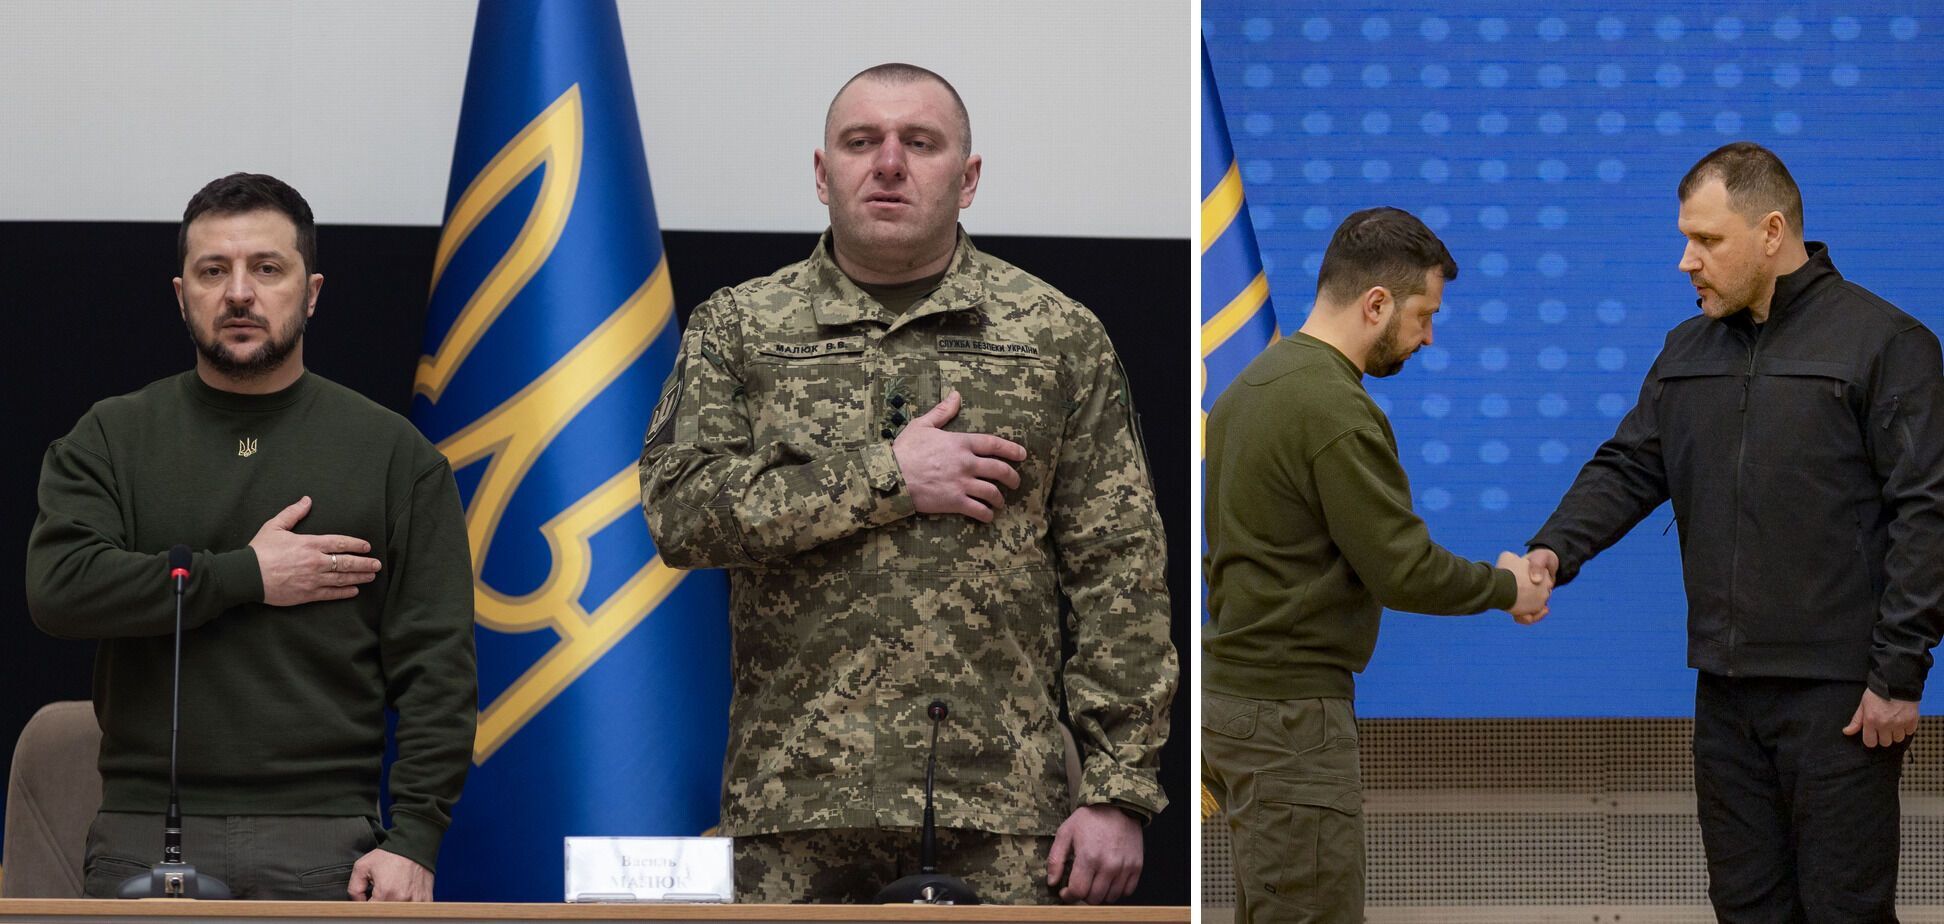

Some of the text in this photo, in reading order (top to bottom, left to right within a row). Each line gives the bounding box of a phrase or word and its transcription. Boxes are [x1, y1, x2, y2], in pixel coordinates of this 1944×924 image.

[775, 343, 819, 354] МАЛЮК
[938, 339, 1038, 355] СЛУЖБА БЕЗПЕКИ УКРАЇНИ
